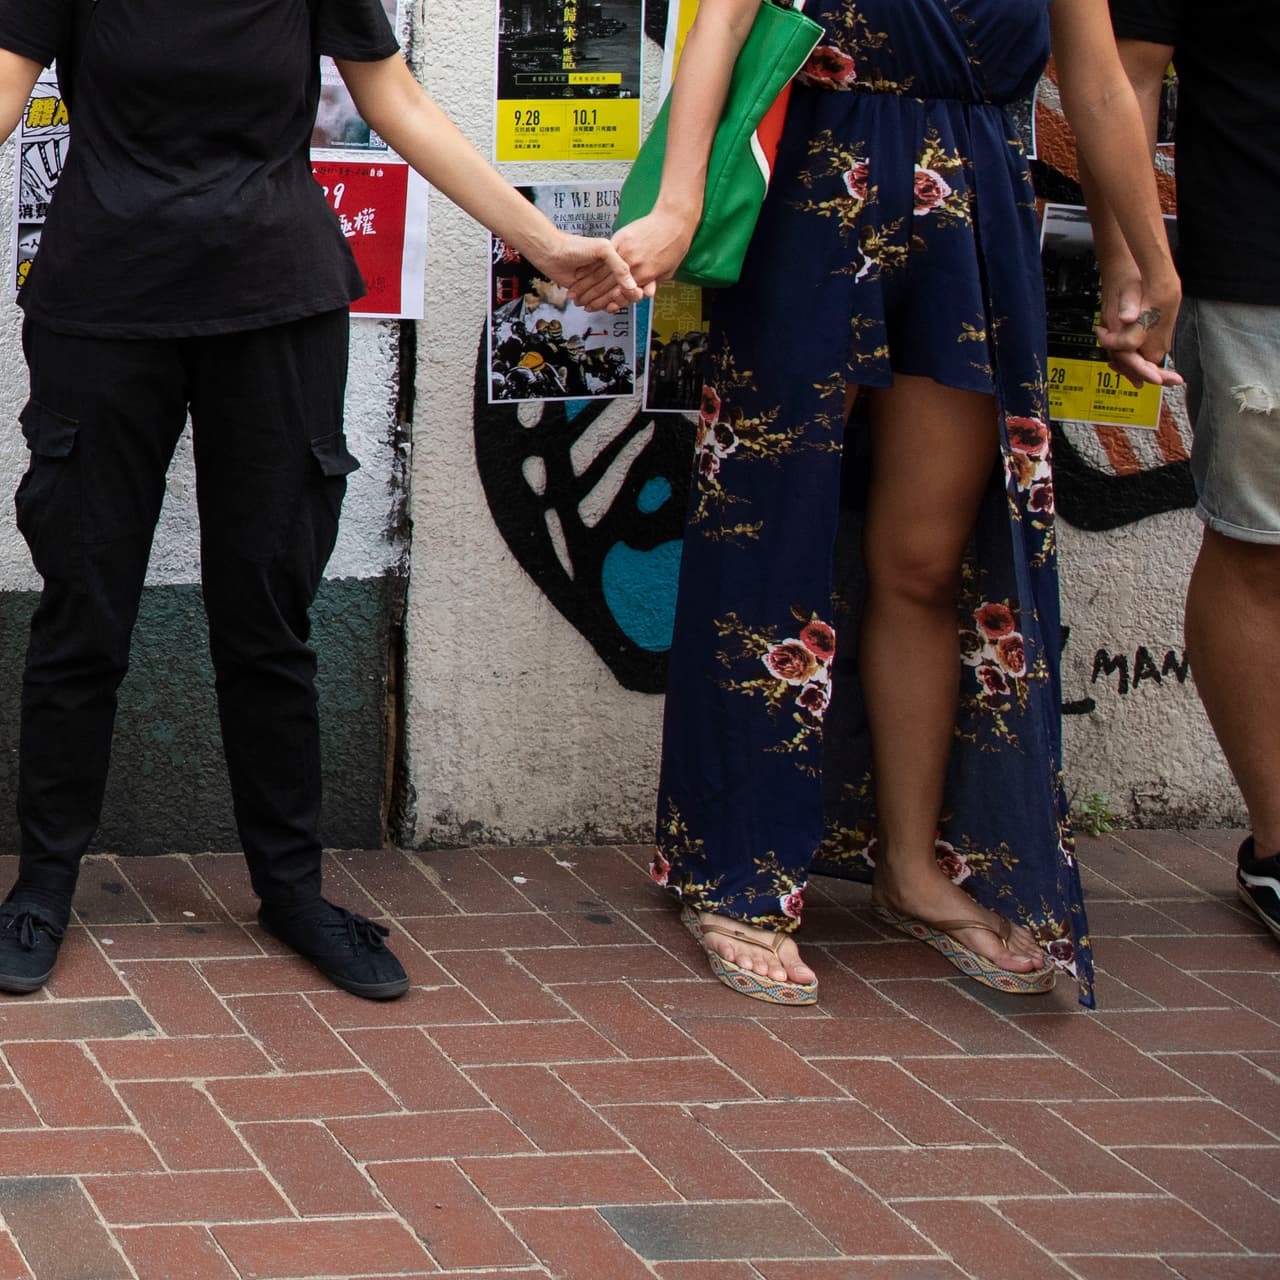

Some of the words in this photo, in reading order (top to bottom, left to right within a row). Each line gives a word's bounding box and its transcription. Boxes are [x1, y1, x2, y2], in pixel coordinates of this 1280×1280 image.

[514, 110, 540, 126] 9.28
[572, 109, 597, 125] 10.1
[553, 191, 567, 208] IF
[571, 191, 591, 208] WE
[1097, 371, 1121, 389] 10.1
